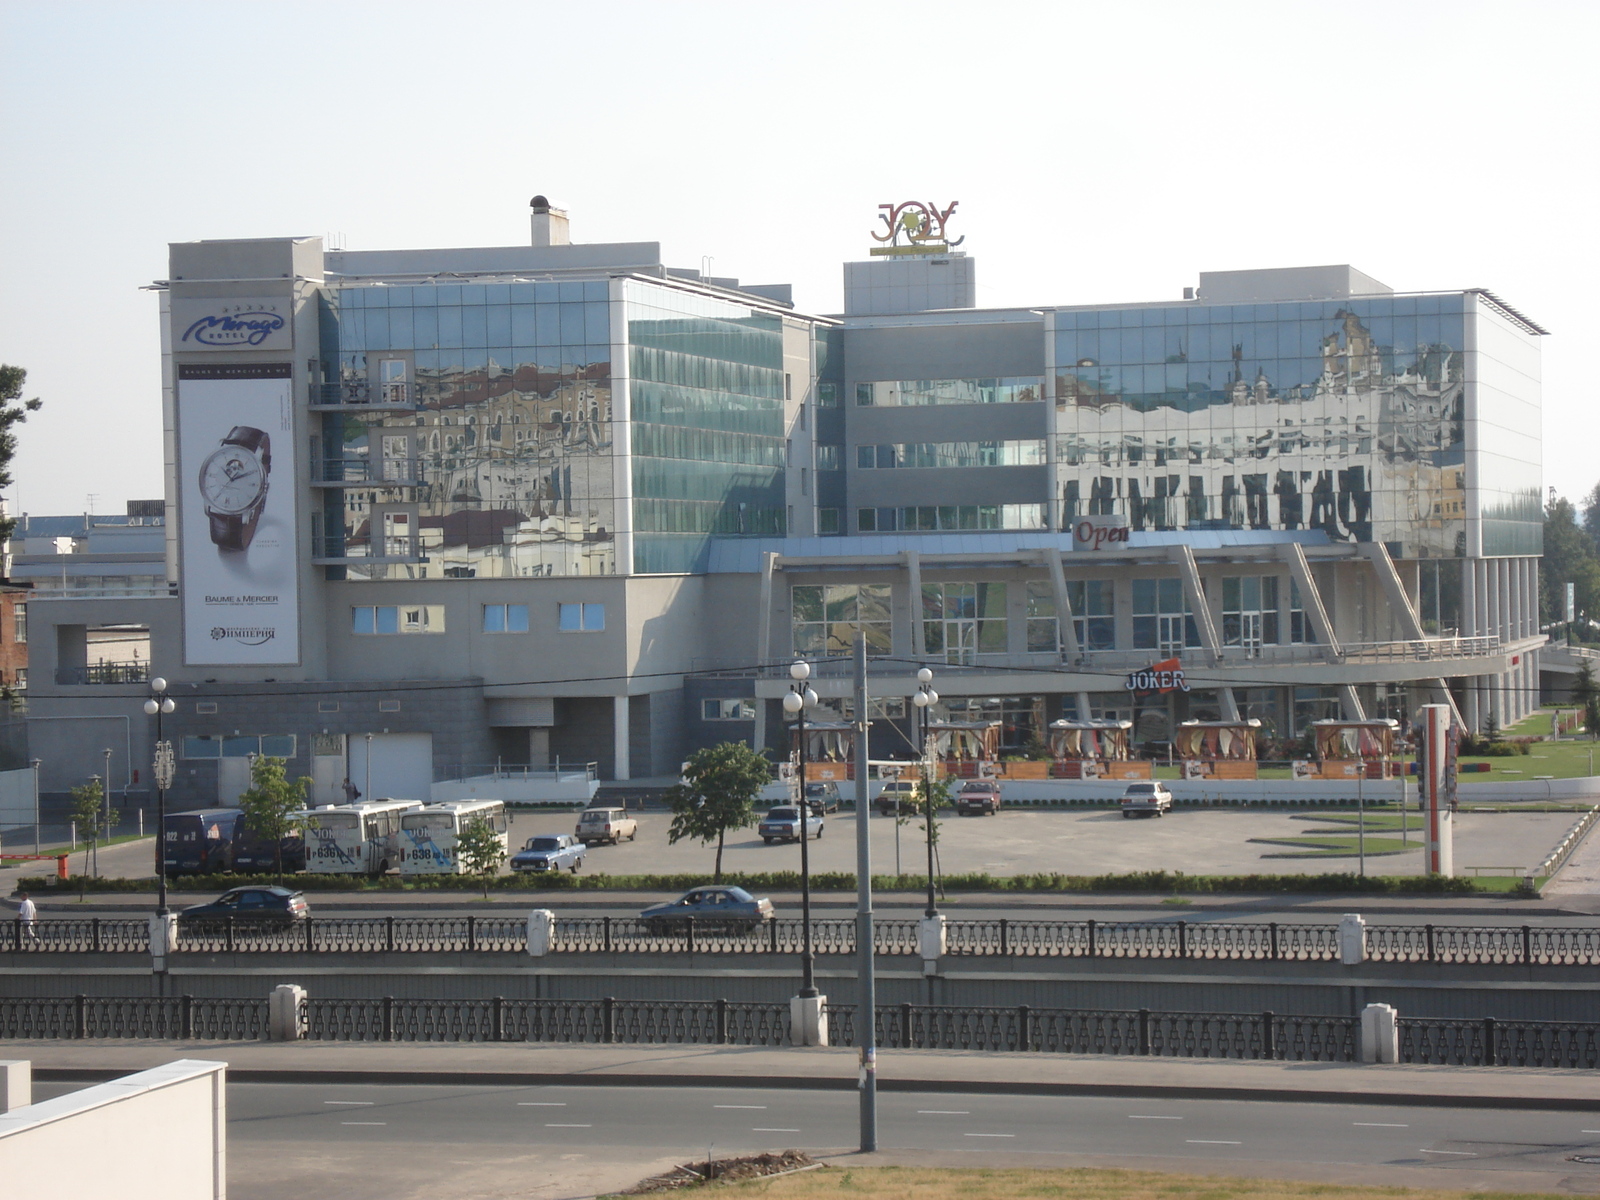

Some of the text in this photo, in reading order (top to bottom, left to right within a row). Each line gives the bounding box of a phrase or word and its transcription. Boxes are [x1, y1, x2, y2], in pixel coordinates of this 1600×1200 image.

[182, 312, 284, 345] Mirage
[1076, 521, 1129, 550] Open
[226, 630, 275, 638] ИМПЕРИЯ
[1125, 670, 1191, 692] JOKER
[317, 847, 336, 858] 636
